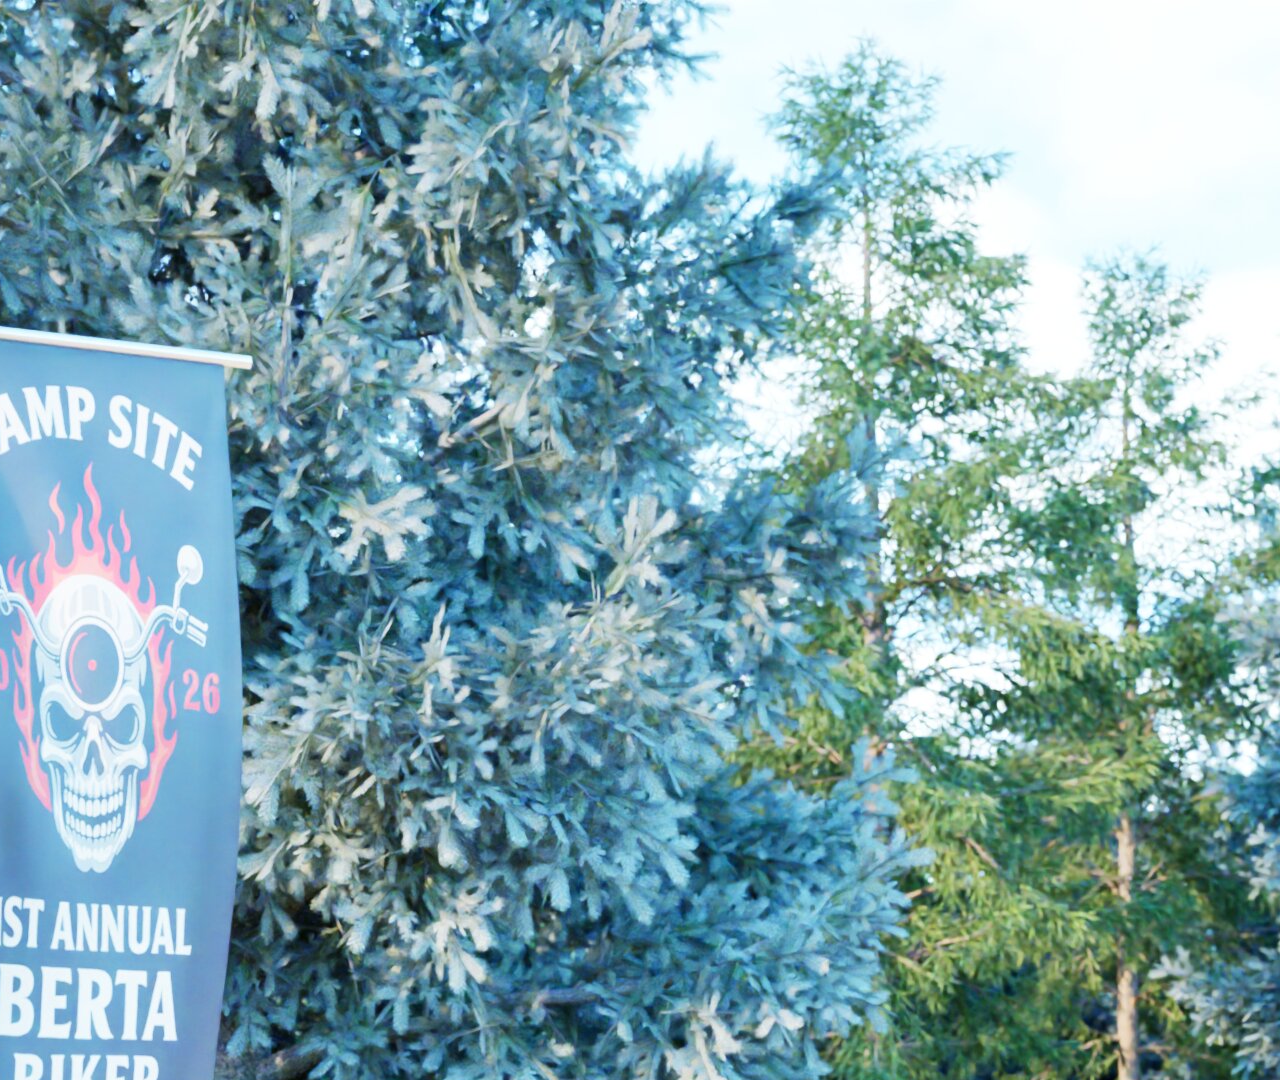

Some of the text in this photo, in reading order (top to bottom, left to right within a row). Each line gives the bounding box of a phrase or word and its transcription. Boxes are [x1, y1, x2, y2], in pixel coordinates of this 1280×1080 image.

[108, 395, 203, 491] SITE
[182, 669, 219, 714] 26
[50, 901, 192, 956] ANNUAL
